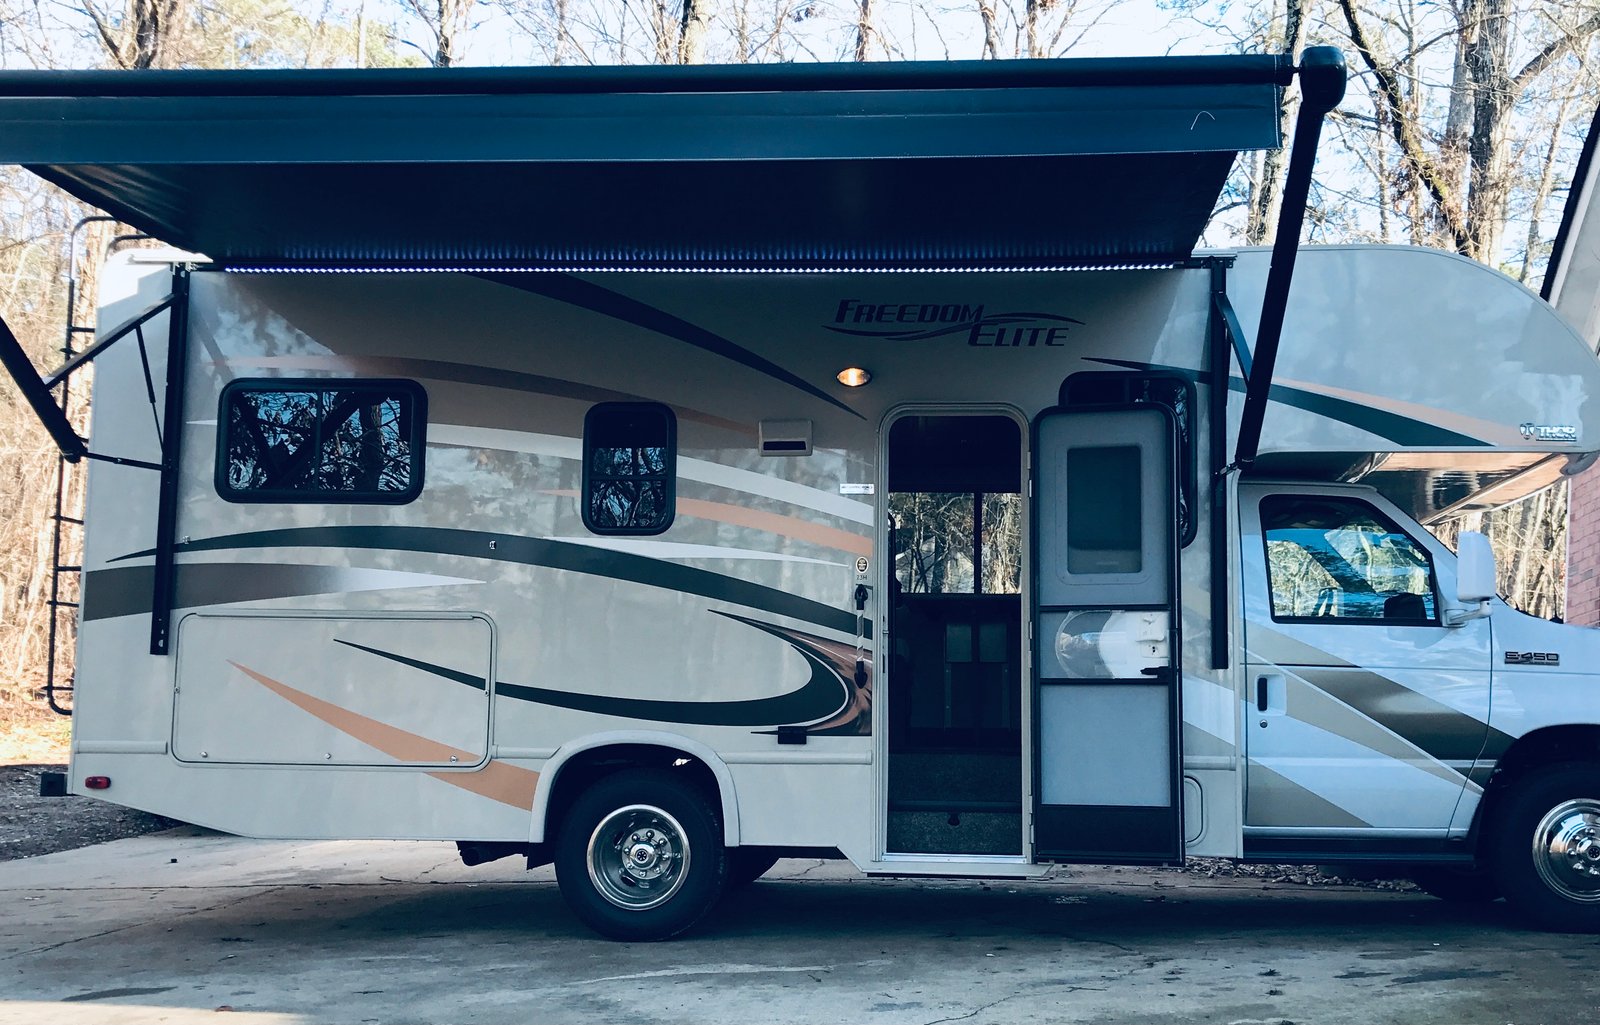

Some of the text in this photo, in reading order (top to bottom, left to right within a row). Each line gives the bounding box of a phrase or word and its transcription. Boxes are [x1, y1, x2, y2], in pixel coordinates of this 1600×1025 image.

[834, 299, 985, 323] FREEDOM
[967, 322, 1069, 347] ELITE
[1536, 425, 1577, 439] THOR
